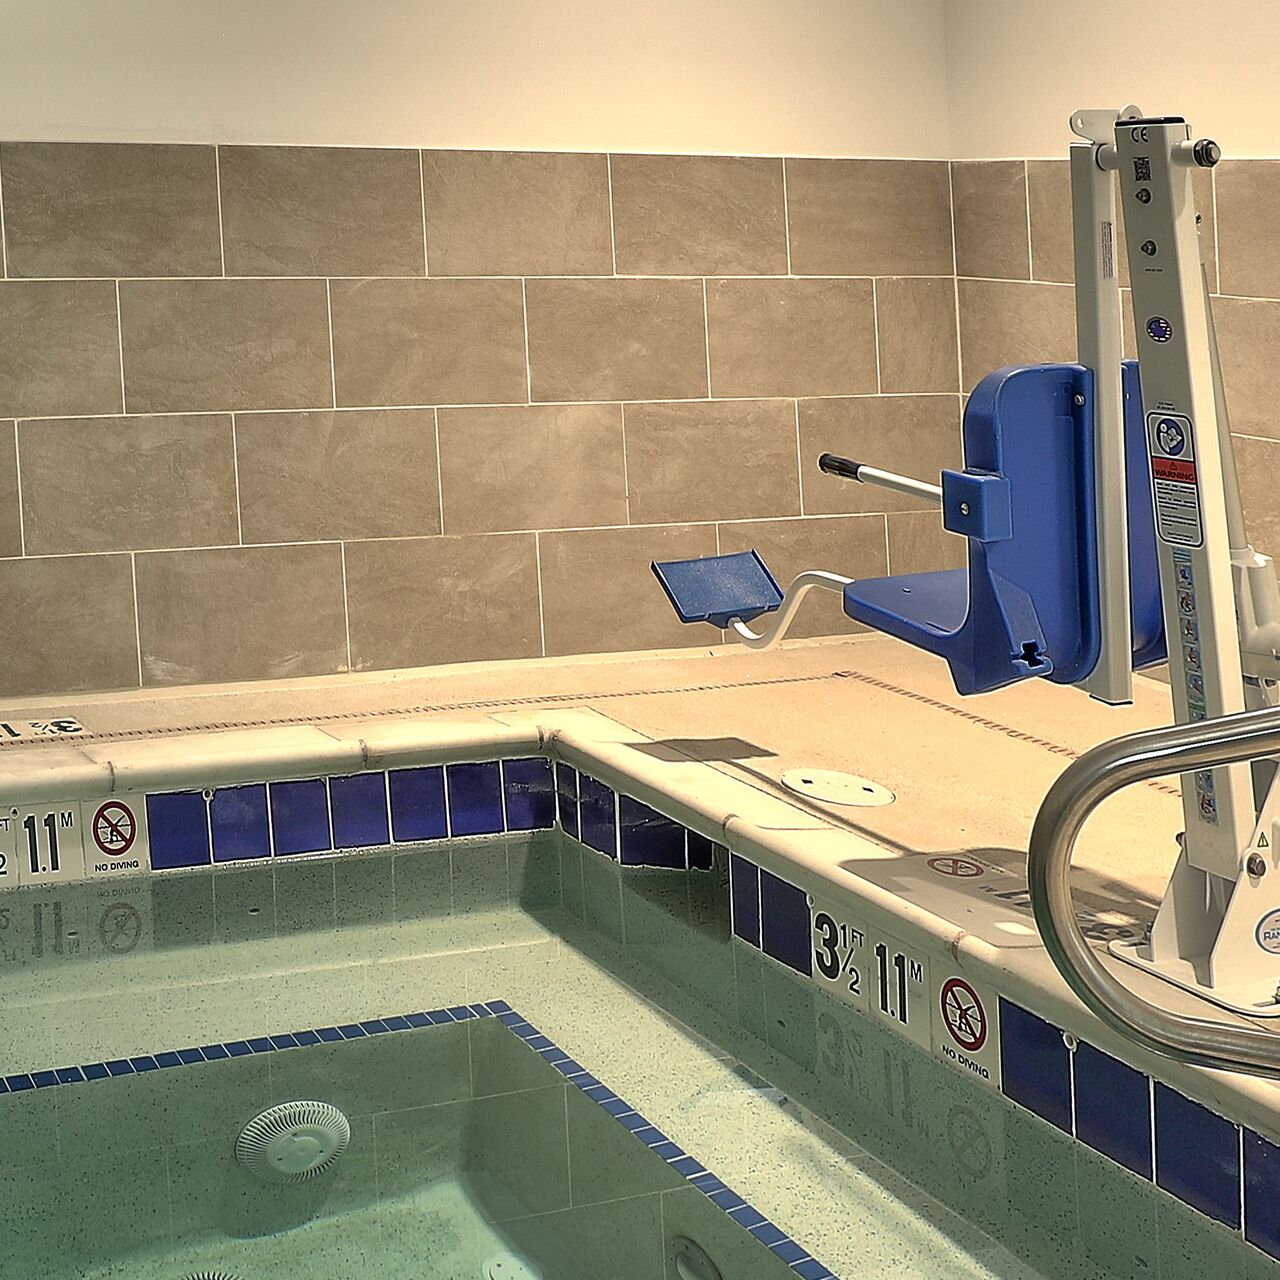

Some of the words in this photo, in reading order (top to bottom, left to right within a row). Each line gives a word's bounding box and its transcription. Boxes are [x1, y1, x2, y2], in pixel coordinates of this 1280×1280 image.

[1131, 126, 1149, 143] CE
[1155, 469, 1195, 482] WARNING
[23, 812, 60, 874] 1.1
[60, 811, 73, 828] M
[94, 863, 108, 872] NO
[109, 860, 140, 871] DIVING
[851, 927, 865, 948] FT
[874, 942, 908, 1026] 1.1
[910, 962, 924, 984] M
[942, 1044, 956, 1060] NO
[957, 1055, 990, 1080] DIVING
